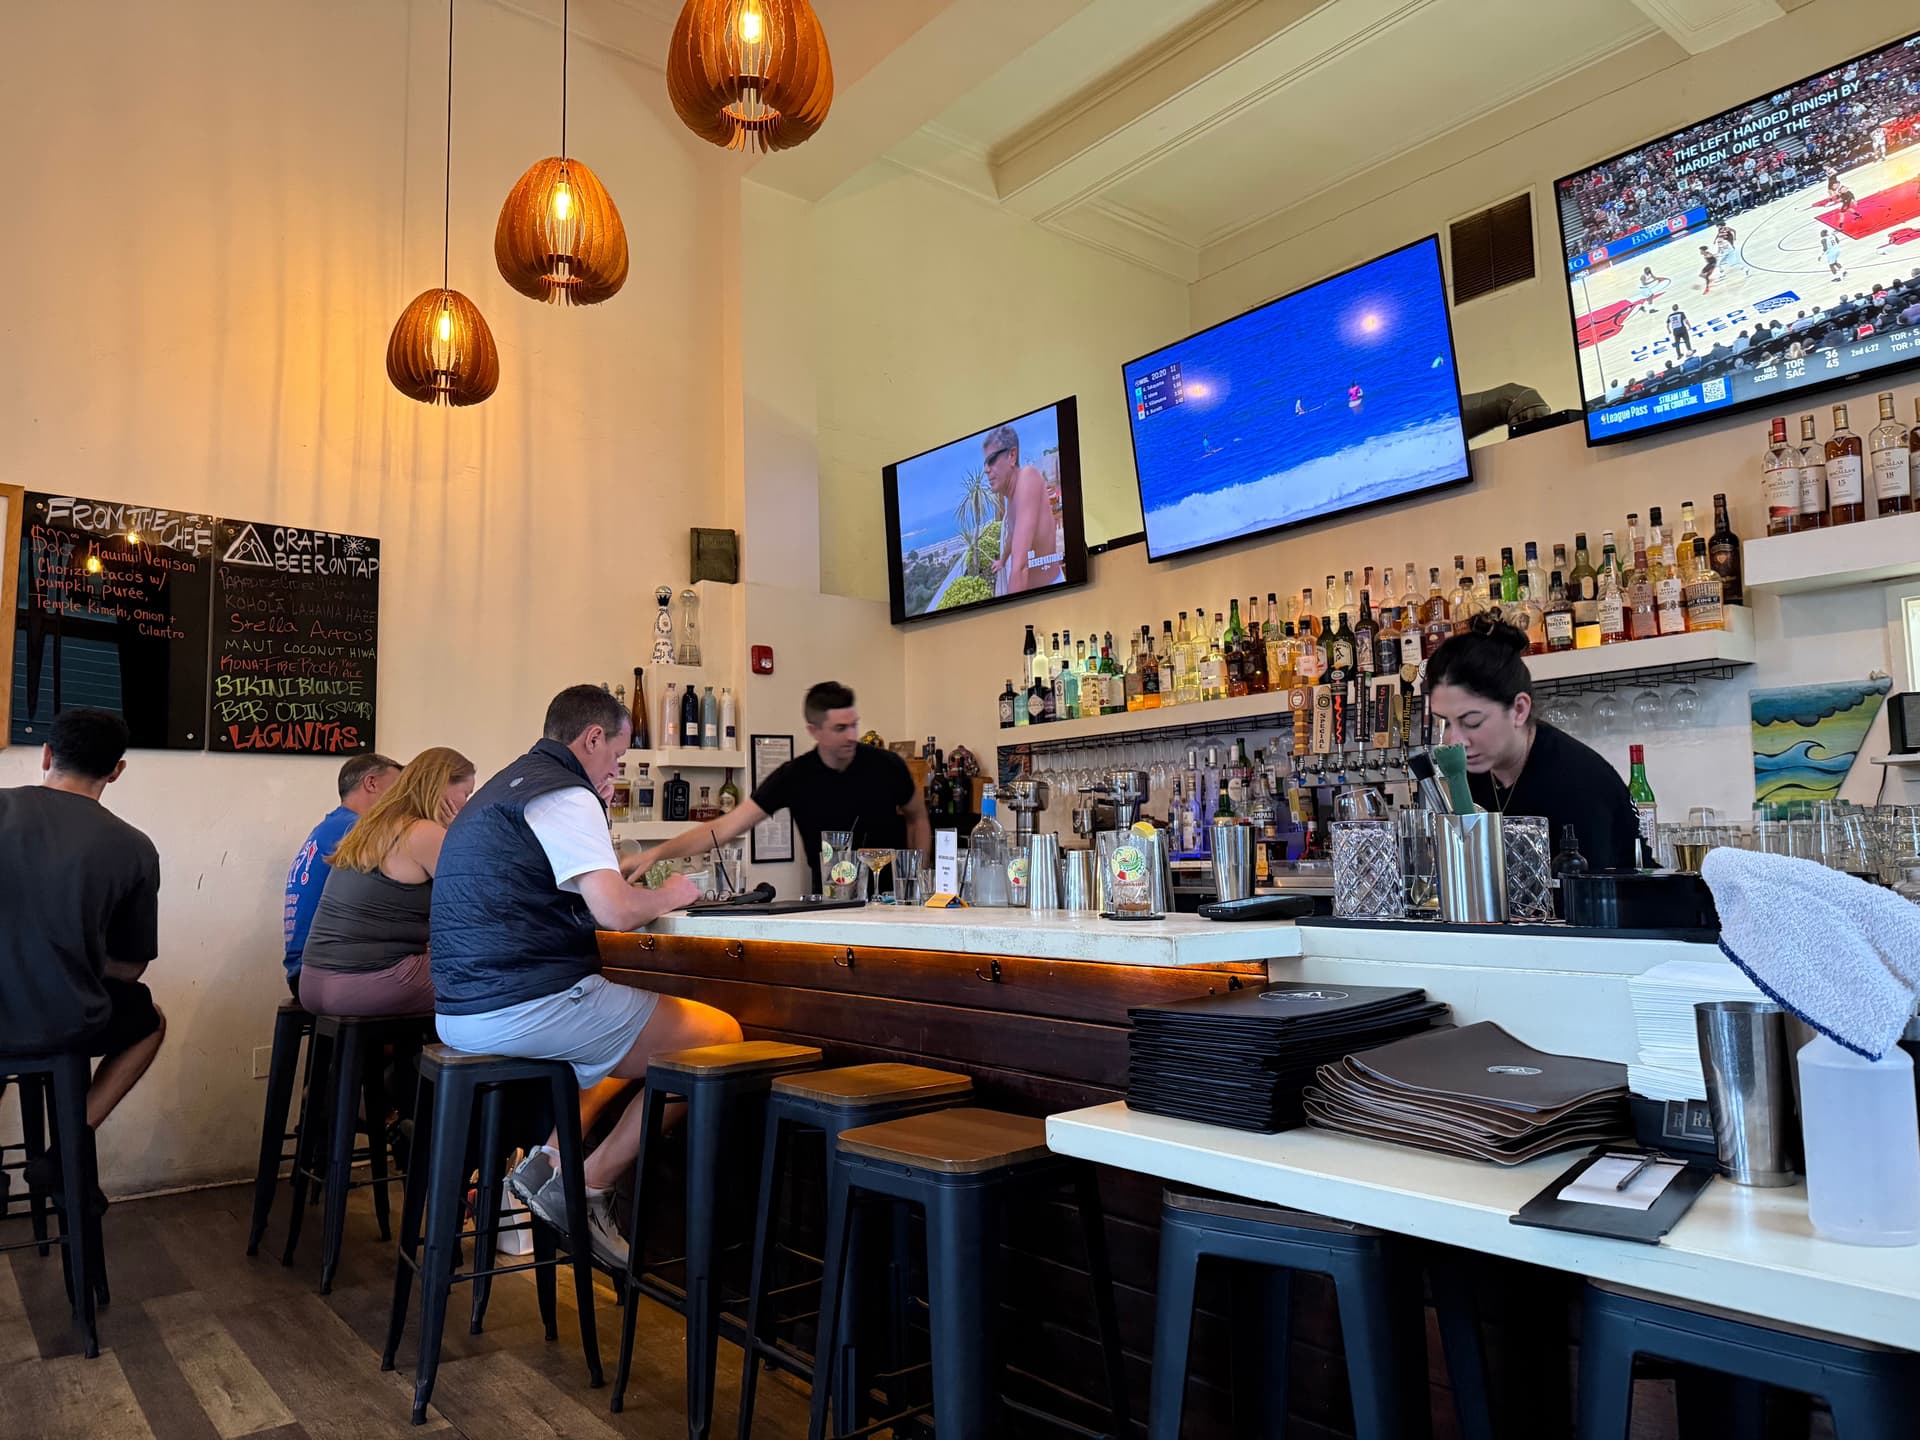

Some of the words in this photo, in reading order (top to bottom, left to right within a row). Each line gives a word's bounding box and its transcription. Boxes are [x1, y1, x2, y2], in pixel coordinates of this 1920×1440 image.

[1672, 146, 1698, 163] THE
[1699, 132, 1731, 153] LEFT
[1732, 109, 1789, 141] HANDED
[1791, 89, 1838, 117] FINISH
[1840, 79, 1861, 98] BY
[1674, 151, 1731, 177] HARDEN.
[1732, 136, 1761, 154] ONE
[1763, 128, 1781, 143] OF
[1782, 115, 1812, 134] THE
[1889, 331, 1908, 342] TOR
[1890, 341, 1909, 352] TOR
[1784, 358, 1805, 370] TOR
[1824, 350, 1839, 360] 36
[1785, 367, 1806, 379] SAC
[1825, 359, 1840, 370] 45
[1753, 371, 1779, 383] SCORES
[1606, 409, 1631, 424] League
[1630, 404, 1649, 418] Pass
[45, 498, 127, 530] FROM
[126, 508, 168, 532] THE
[160, 519, 212, 551] CHEF
[273, 527, 341, 557] CRAFT
[143, 546, 196, 573] Venison
[274, 552, 329, 576] BEER
[328, 557, 348, 575] ON
[346, 557, 379, 580] TAP
[37, 556, 93, 577] Chorizo
[100, 569, 144, 584] tacos
[149, 573, 167, 592] w/
[36, 577, 95, 597] pumpkin
[28, 592, 82, 616] Temple
[138, 622, 185, 640] Cilantro
[230, 612, 300, 633] Stella
[283, 642, 345, 656] COCONUT
[350, 646, 377, 660] HIWA
[215, 674, 299, 698] BIKINI
[228, 721, 359, 753] LAGUNITAS
